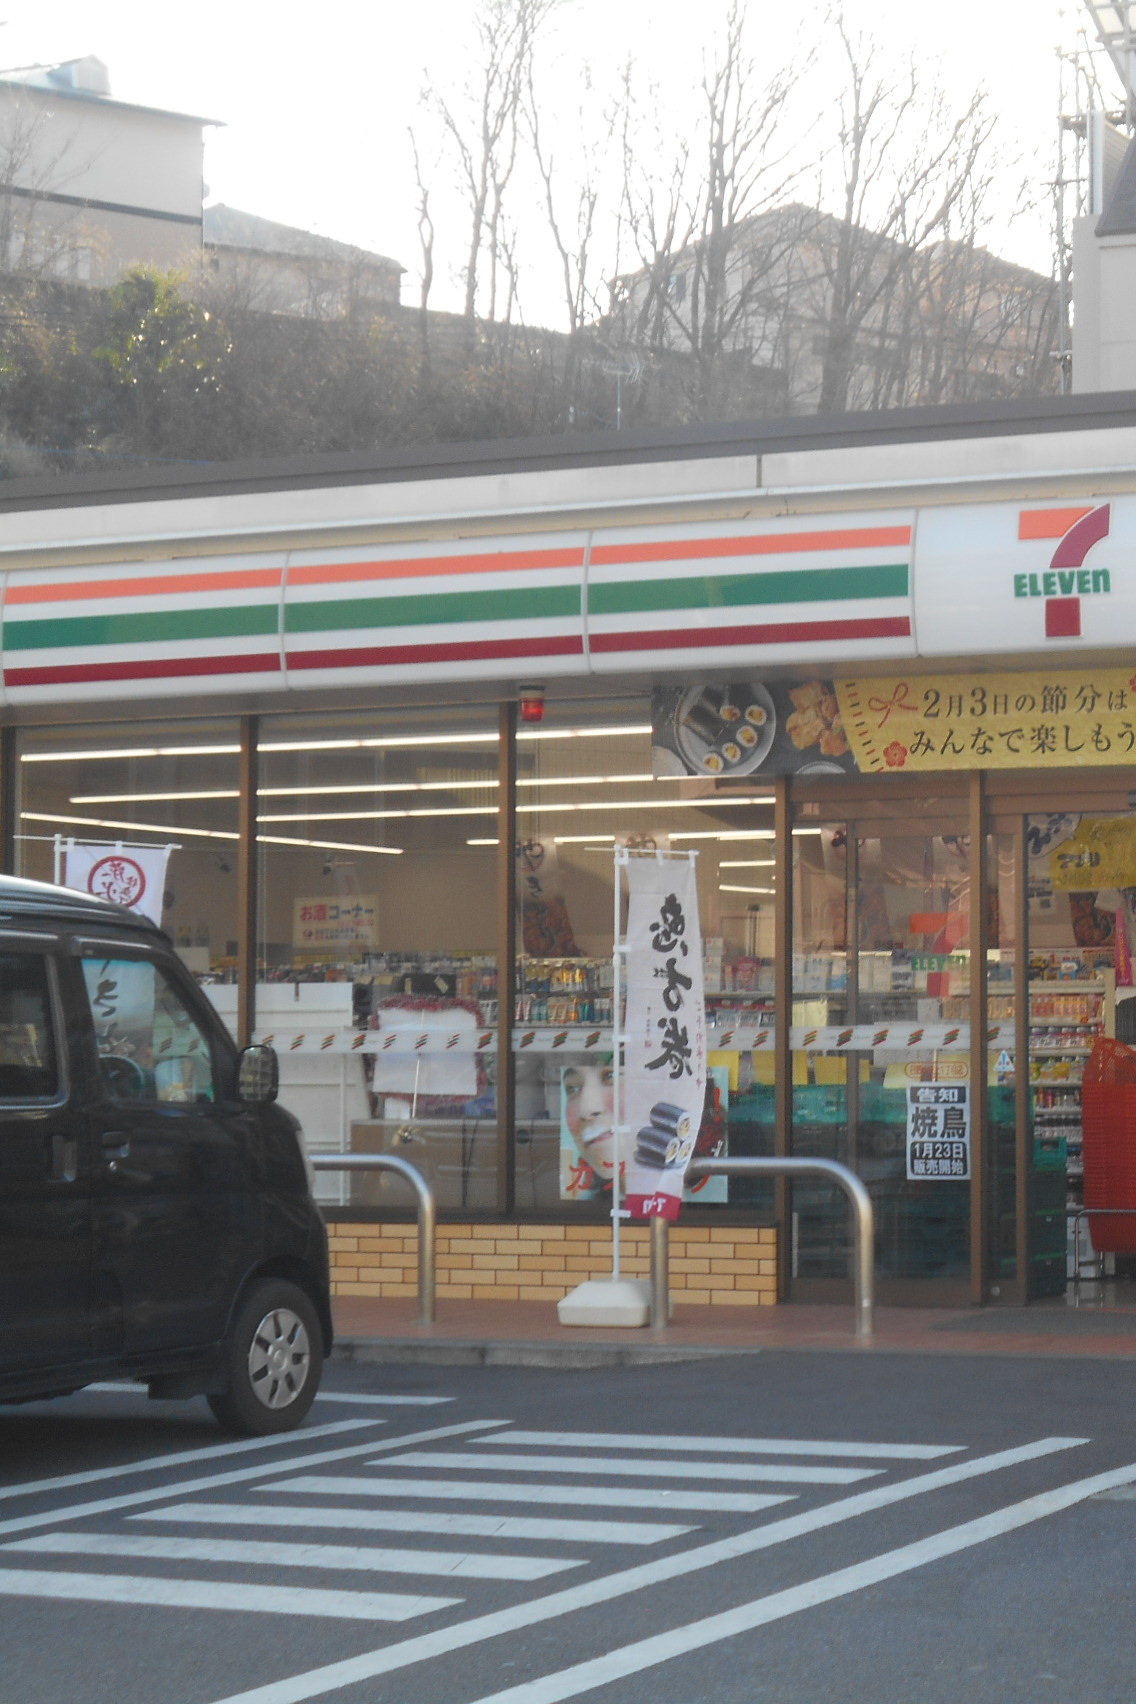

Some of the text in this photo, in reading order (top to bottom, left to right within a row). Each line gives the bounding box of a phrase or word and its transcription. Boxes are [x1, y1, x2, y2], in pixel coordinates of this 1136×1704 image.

[923, 683, 1129, 719] 2月3日の節分は
[910, 721, 1136, 756] みんなで楽しもう
[916, 1088, 958, 1102] 告知
[911, 1106, 966, 1139] 焼鳥
[914, 1142, 963, 1158] 1月23日
[914, 1159, 963, 1174] 販売開始
